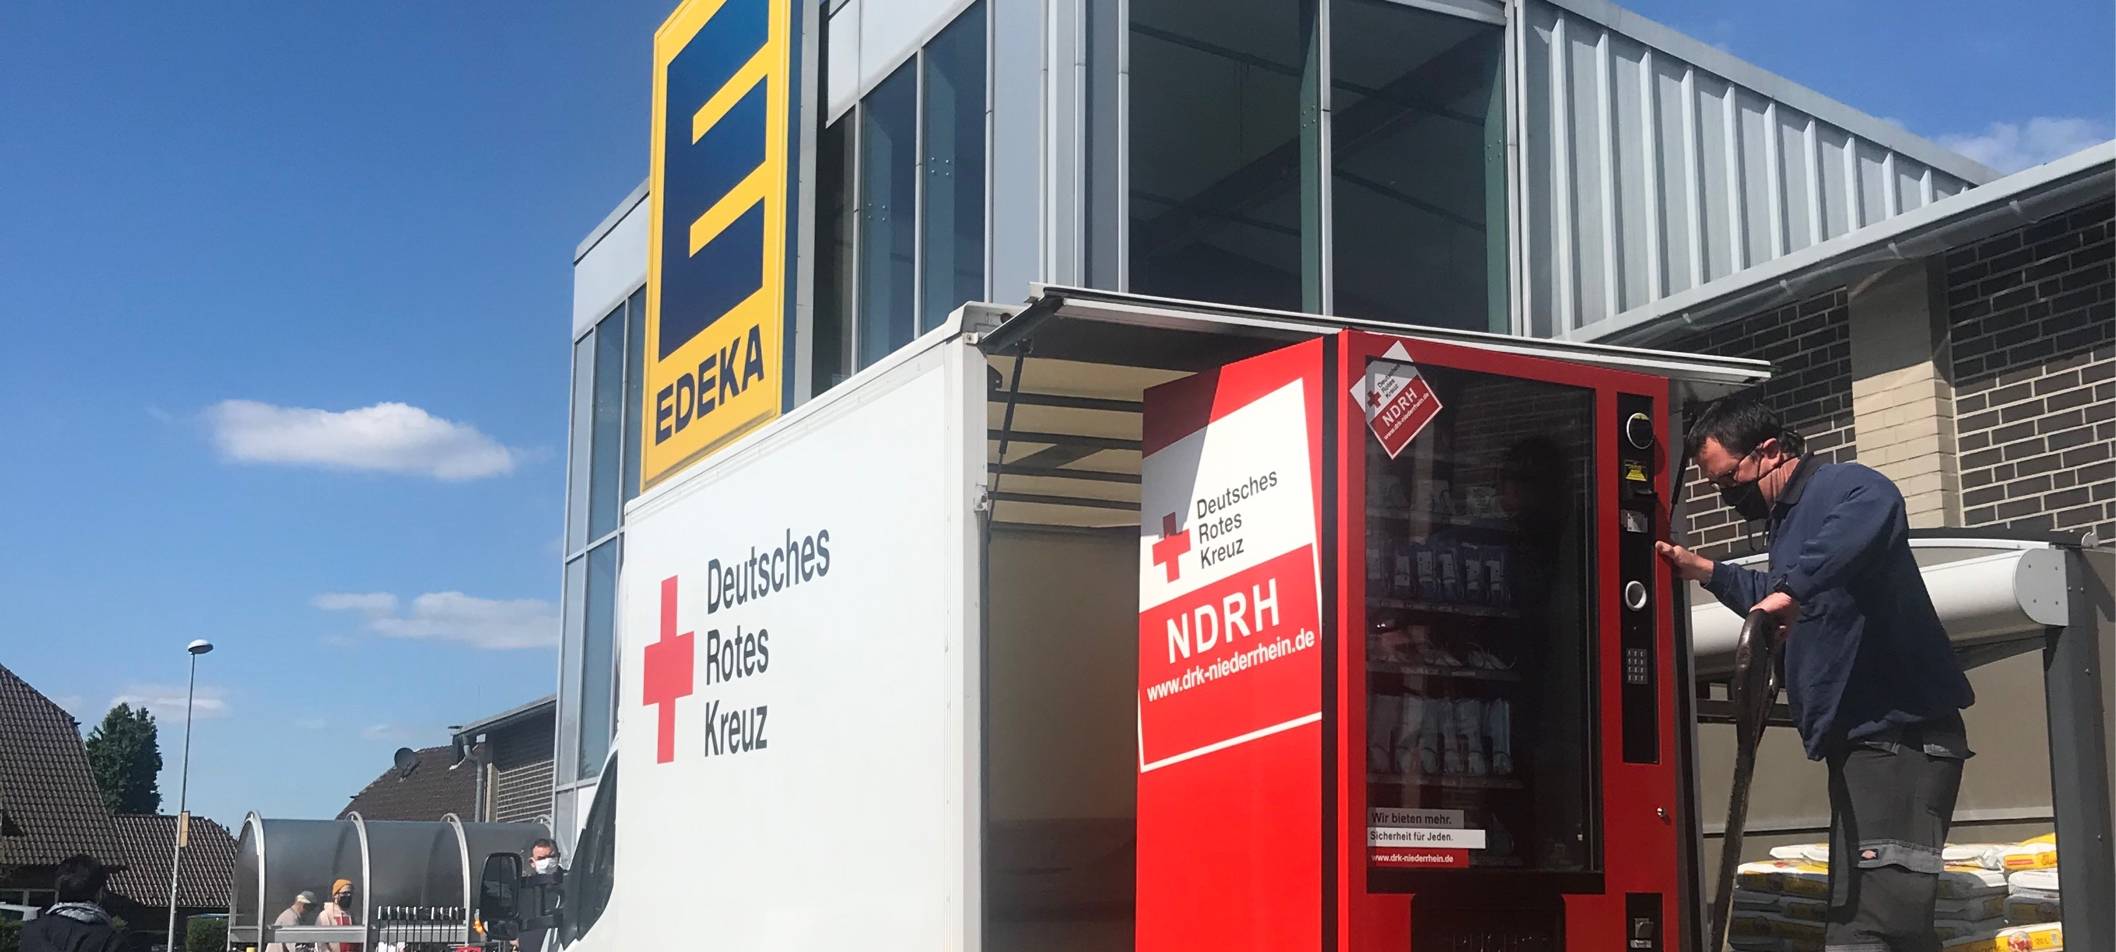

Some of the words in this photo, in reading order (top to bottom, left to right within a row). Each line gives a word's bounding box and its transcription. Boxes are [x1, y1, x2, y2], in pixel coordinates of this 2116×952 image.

[655, 323, 765, 446] EDEKA
[1382, 387, 1418, 427] NDRH
[1196, 470, 1278, 519] Deutsches
[1199, 512, 1242, 544] Rotes
[707, 528, 830, 615] Deutsches
[1200, 537, 1244, 569] Kreuz
[1166, 577, 1280, 665] NDRH
[706, 625, 769, 686] Rotes
[1147, 627, 1316, 702] www.drk-niederrhein.de
[704, 700, 768, 757] Kreuz
[1370, 831, 1412, 841] Sicherheit
[1413, 832, 1425, 841] für
[1427, 832, 1454, 841] Jeden.
[1371, 812, 1388, 823] Wir
[1391, 813, 1422, 824] bieten
[1424, 814, 1452, 825] mehr.
[1371, 854, 1454, 863] www.drk-niederrhein.de
